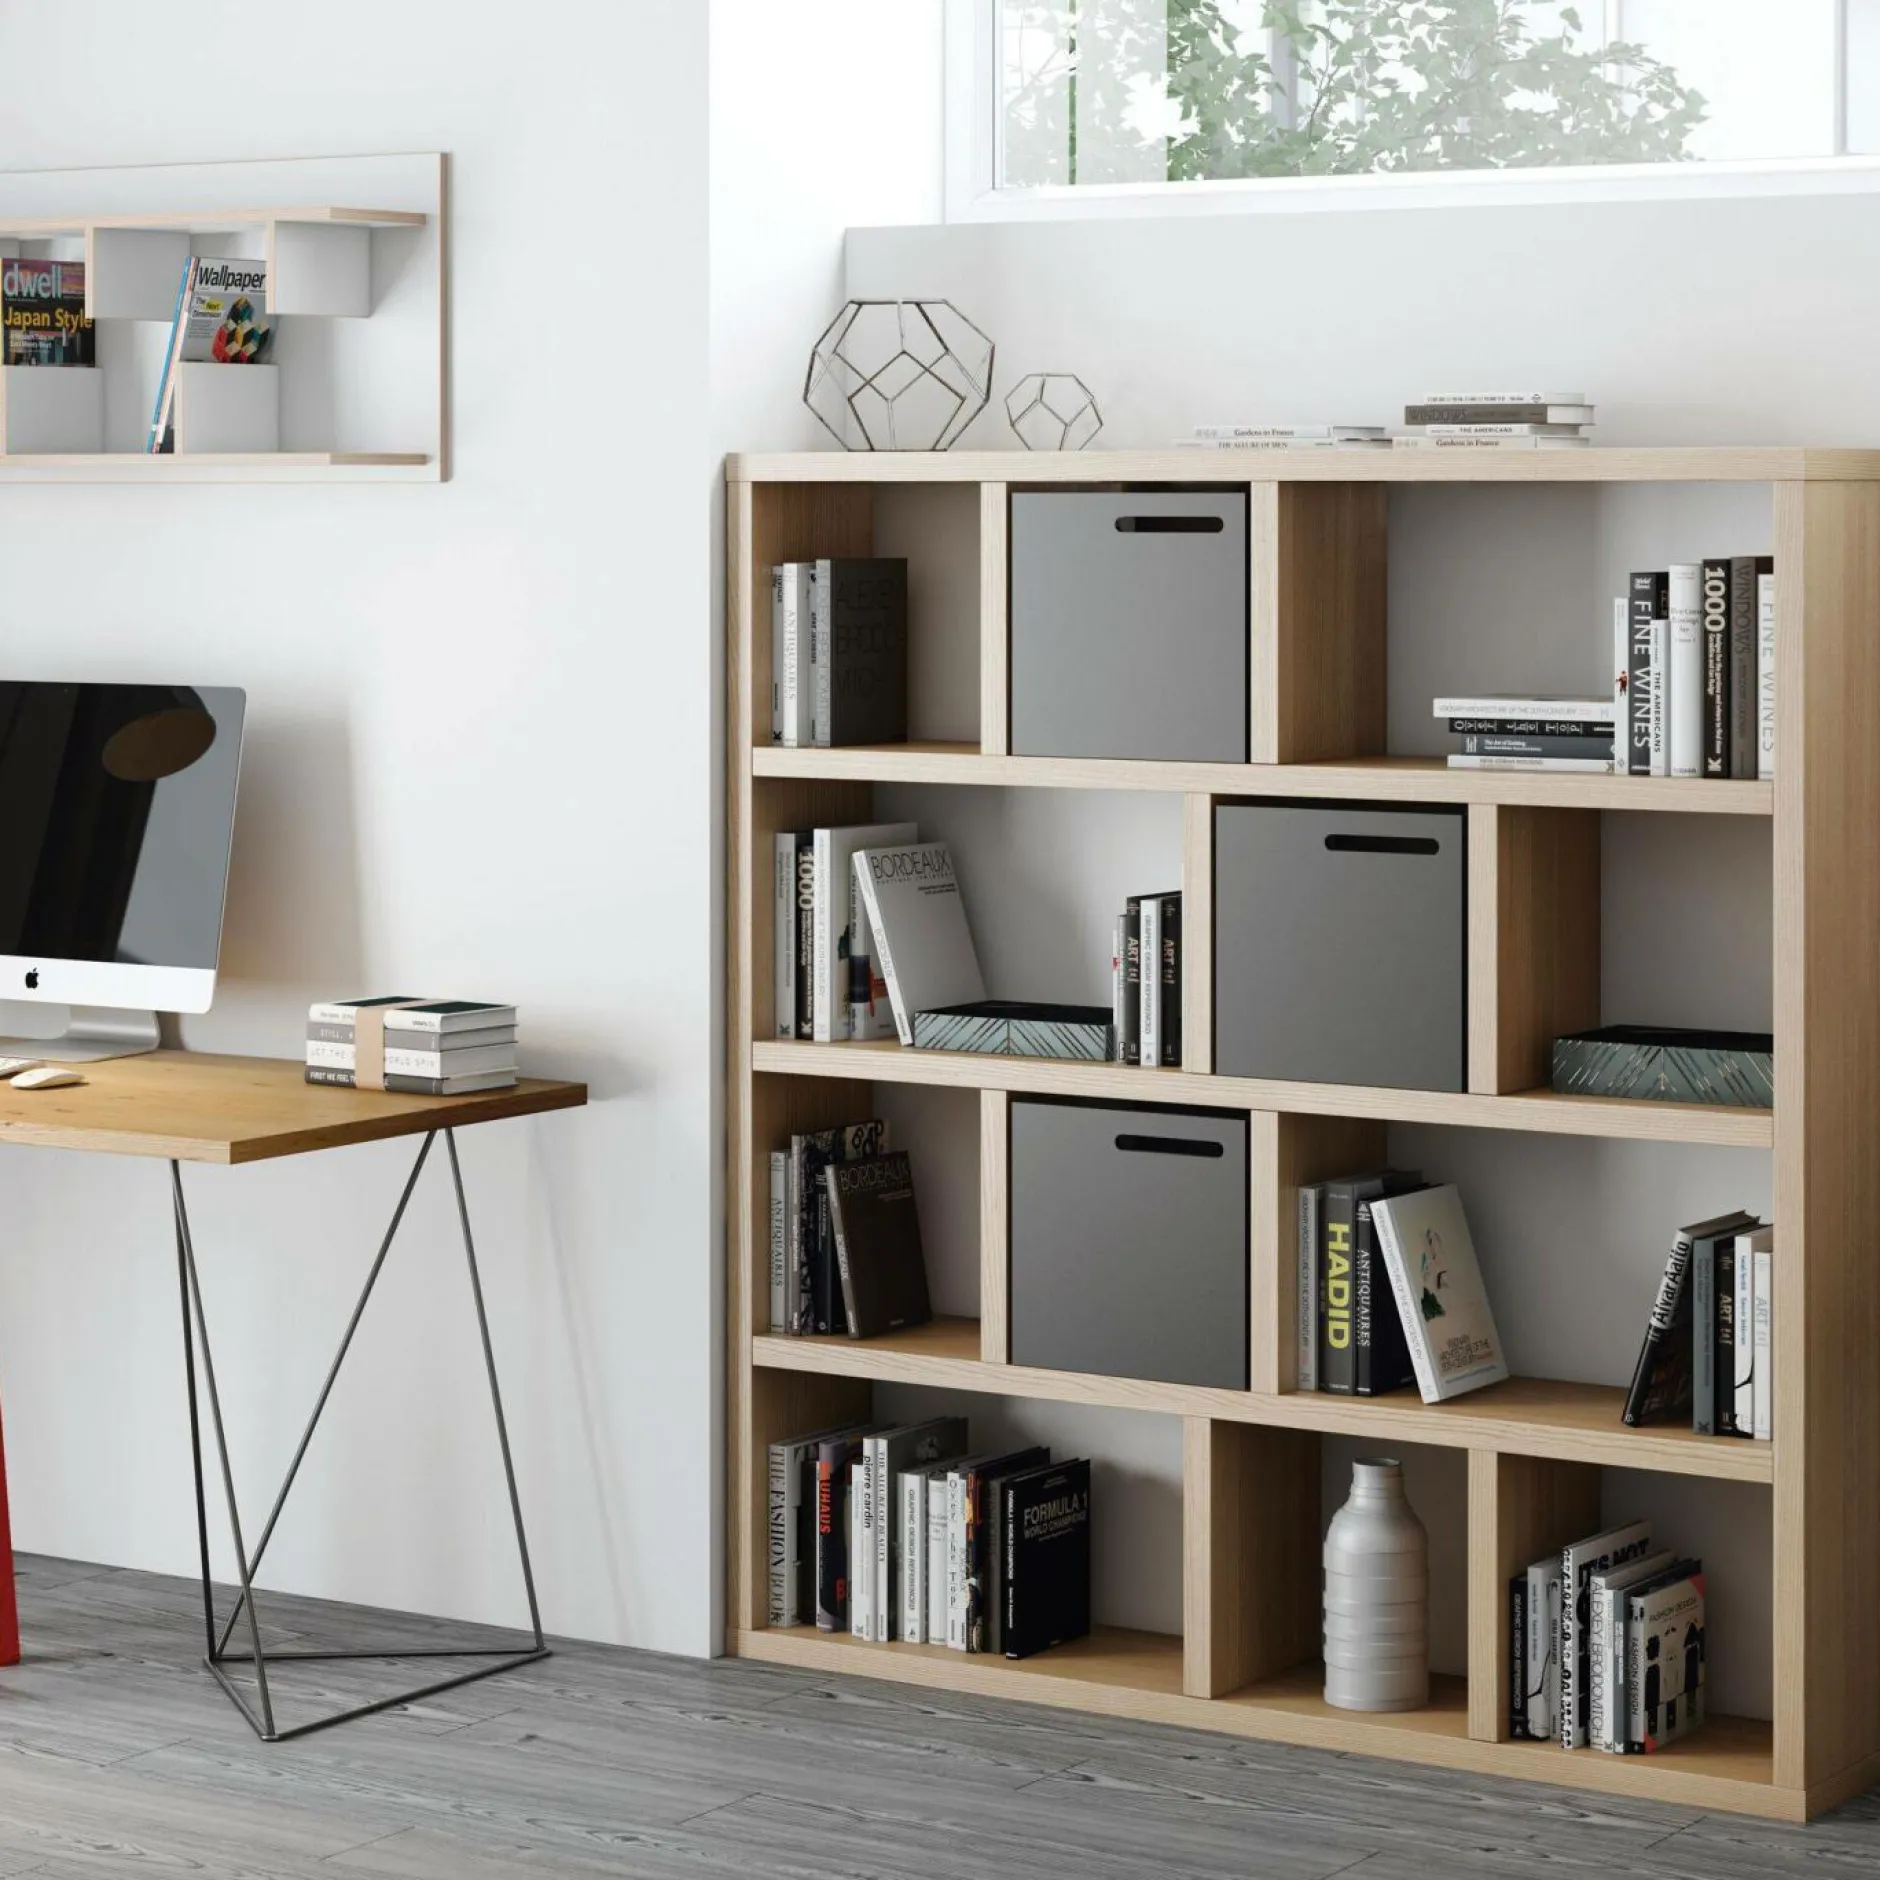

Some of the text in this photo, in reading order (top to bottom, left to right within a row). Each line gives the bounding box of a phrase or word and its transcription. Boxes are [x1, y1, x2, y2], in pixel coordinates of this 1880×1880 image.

[4, 264, 62, 298] dwell
[199, 265, 266, 292] Wallpaper
[6, 307, 92, 333] Japan Style
[1272, 428, 1294, 436] France
[1436, 438, 1464, 447] Gardens
[1475, 438, 1500, 447] France
[1634, 600, 1652, 655] FINE
[1705, 567, 1726, 631] 1000
[1735, 564, 1752, 654] WINDOWS
[788, 610, 798, 701] ANTIQUAIRES
[1762, 602, 1774, 753] FINE WINES
[1546, 723, 1580, 733] Top
[1634, 667, 1652, 748] WINES
[799, 851, 814, 910] 1000
[871, 850, 950, 879] BORDEAUX
[1128, 936, 1139, 964] ART
[1164, 938, 1175, 965] ART
[774, 1197, 784, 1288] ANTIQUAIRES
[1328, 1222, 1350, 1349] HADID
[1360, 1249, 1370, 1347] ANTIQUAIRES
[1652, 1240, 1690, 1325] Alvar Aalto
[1719, 1293, 1732, 1324] ART
[1755, 1296, 1768, 1326] ART
[863, 1456, 873, 1529] pierre cardin
[1023, 1489, 1088, 1528] FORMULA 1
[770, 1447, 786, 1622] THE FASHION BOOK
[1591, 1581, 1604, 1637] ALEXEY
[1591, 1642, 1604, 1739] BRODOVITCH
[1631, 1637, 1639, 1716] FASHION DESIGN
